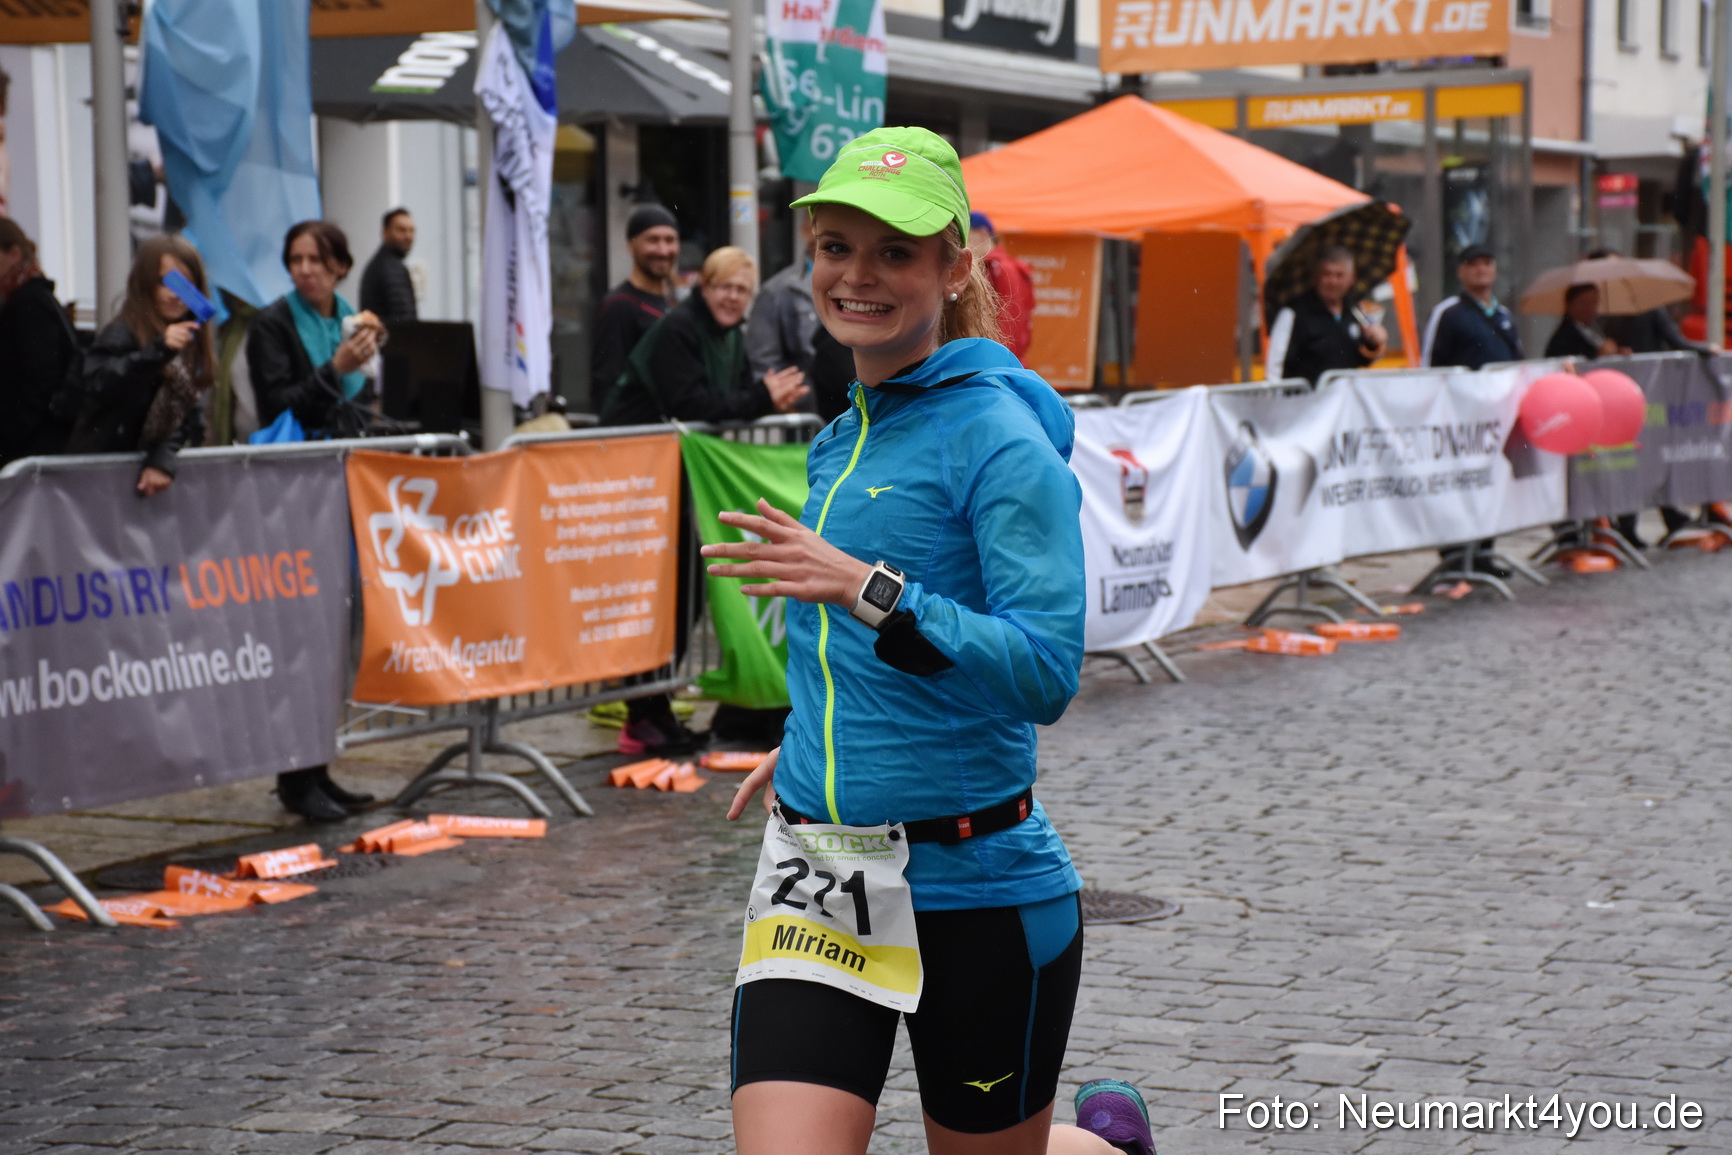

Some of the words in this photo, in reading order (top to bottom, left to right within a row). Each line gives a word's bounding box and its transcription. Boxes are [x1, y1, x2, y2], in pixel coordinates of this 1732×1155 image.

[1111, 0, 1491, 49] RUNMARKT.DE
[858, 166, 901, 175] CHALLENGE
[452, 508, 514, 547] CODE
[179, 549, 319, 610] LOUNGE
[0, 632, 274, 719] w.bockonline.de
[795, 832, 893, 853] BOCK
[837, 854, 860, 862] smart
[862, 853, 896, 862] concepts
[771, 924, 867, 973] Miriam
